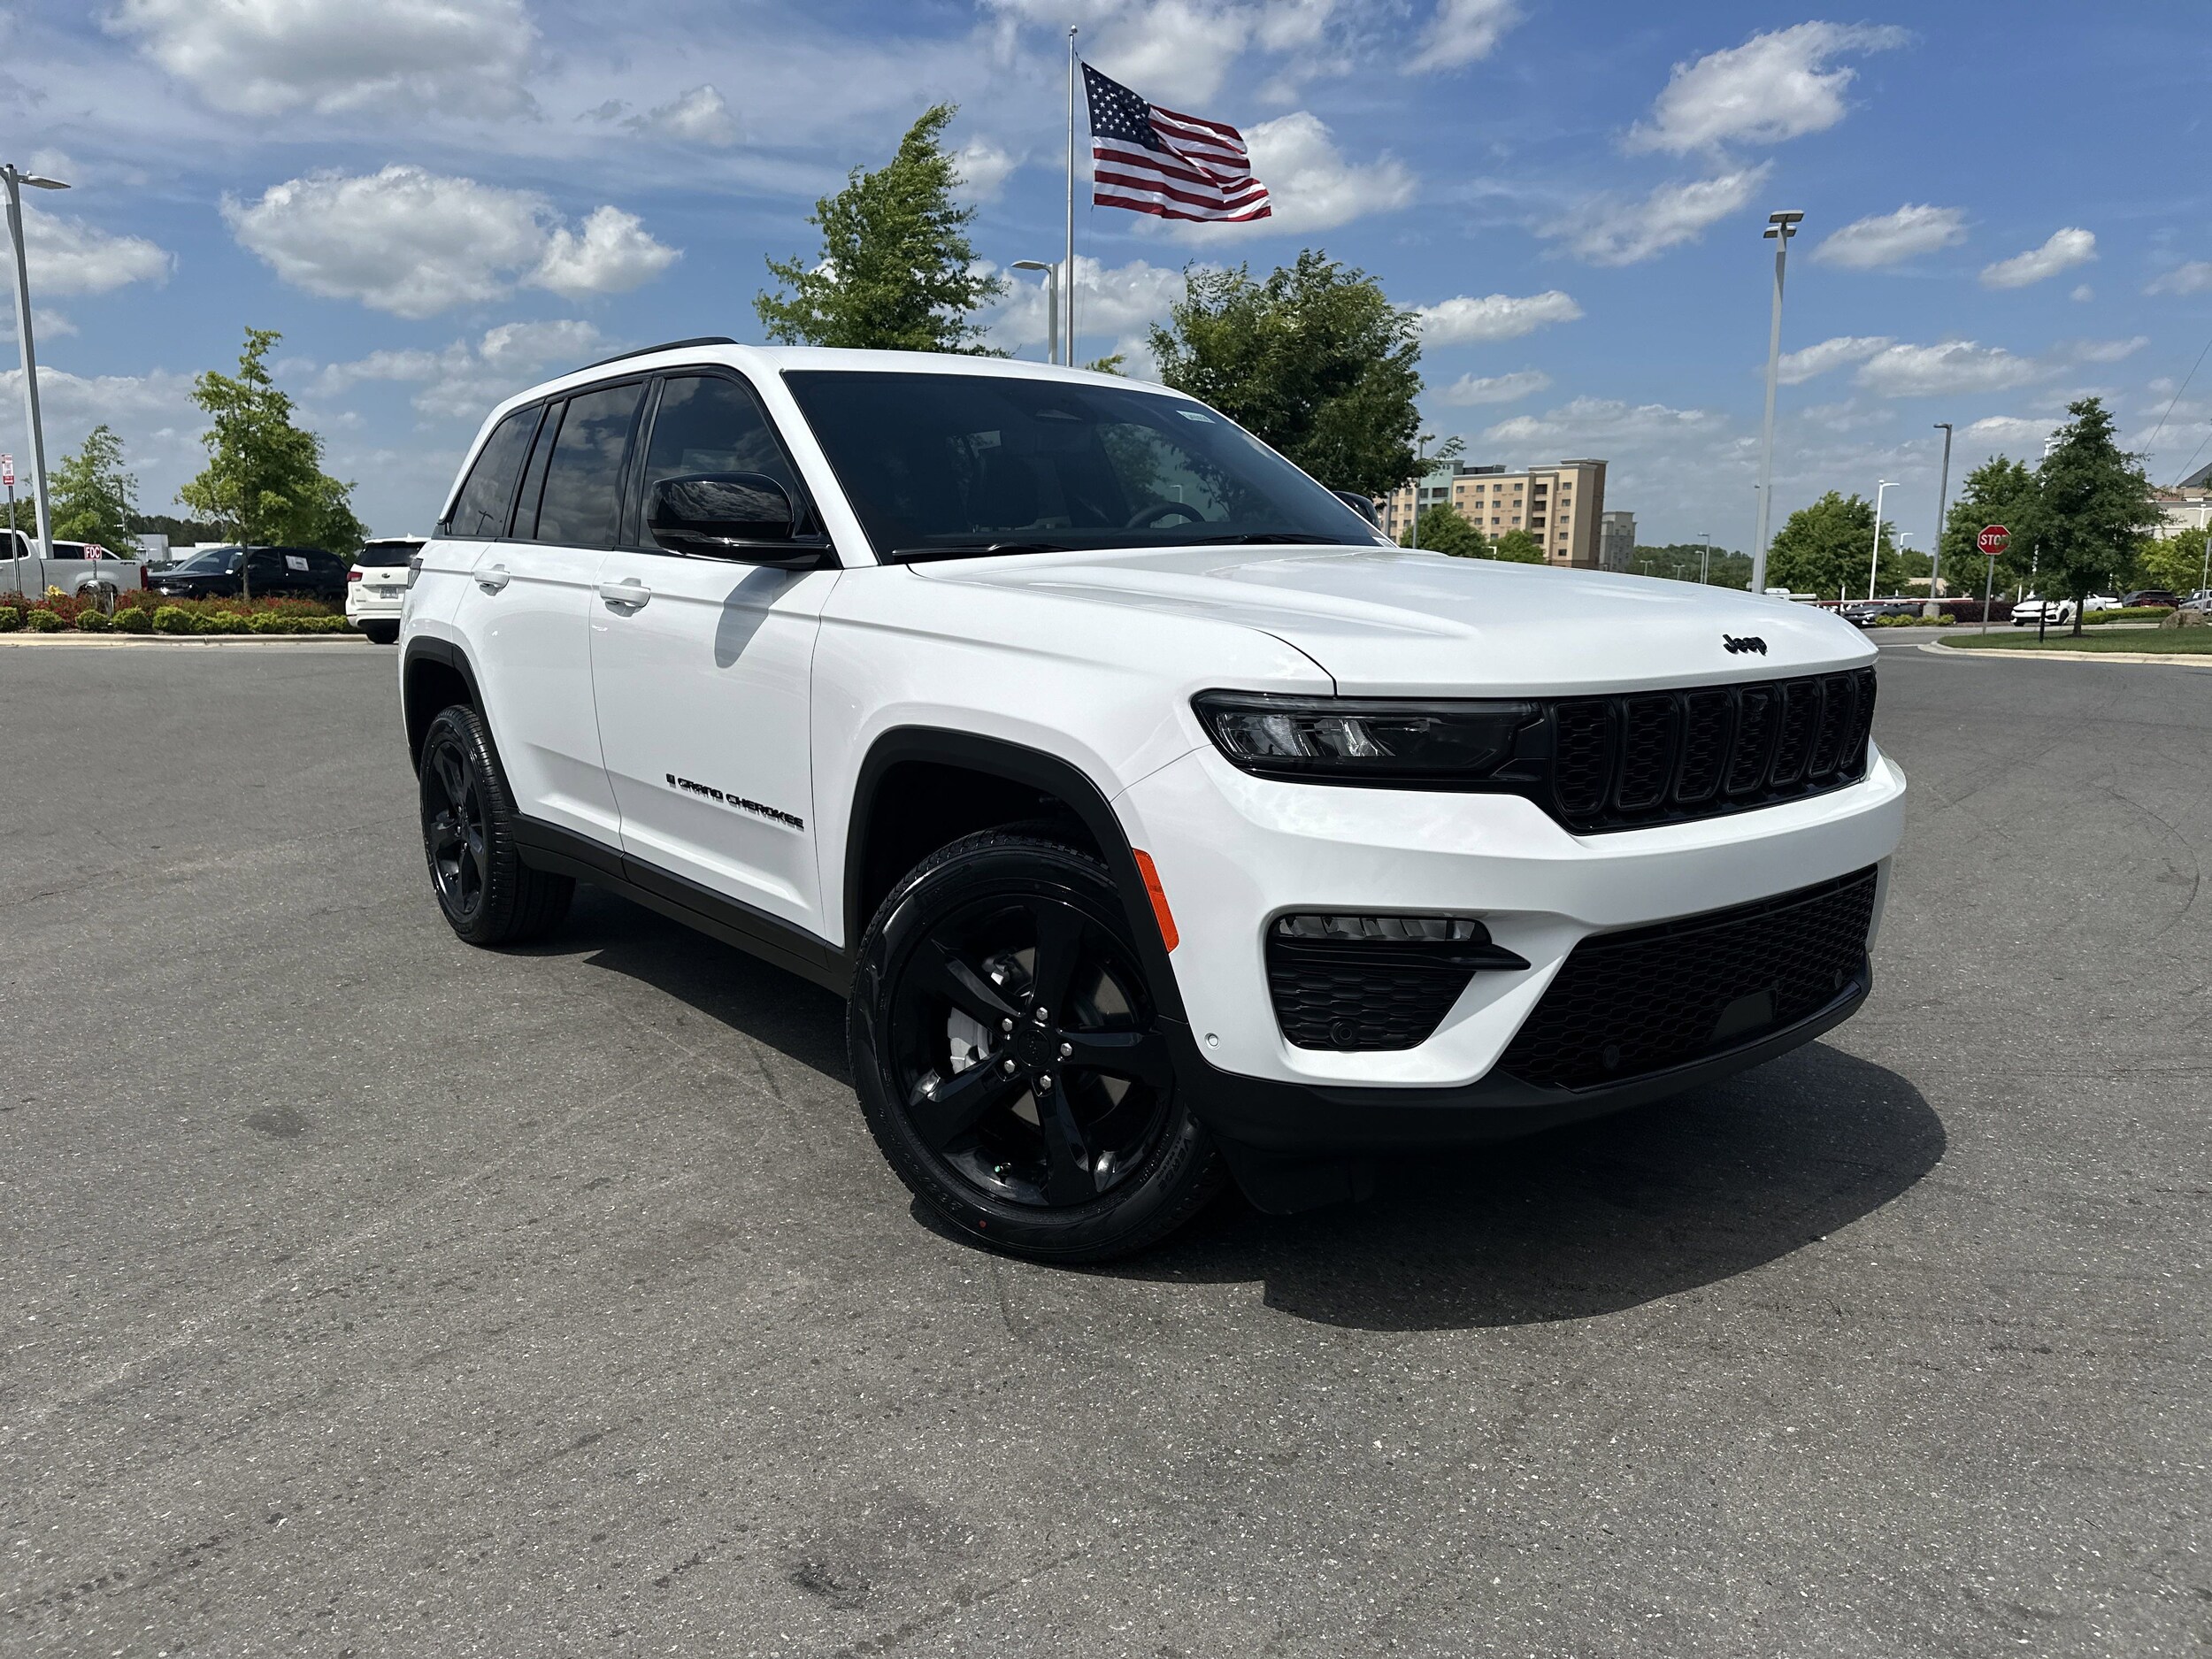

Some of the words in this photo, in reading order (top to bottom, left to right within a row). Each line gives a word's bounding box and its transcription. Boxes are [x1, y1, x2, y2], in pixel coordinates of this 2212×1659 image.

[85, 546, 100, 558] FDC
[1722, 634, 1768, 657] Jeep
[678, 778, 724, 800] GRAND
[726, 794, 804, 829] CHEROKEE
